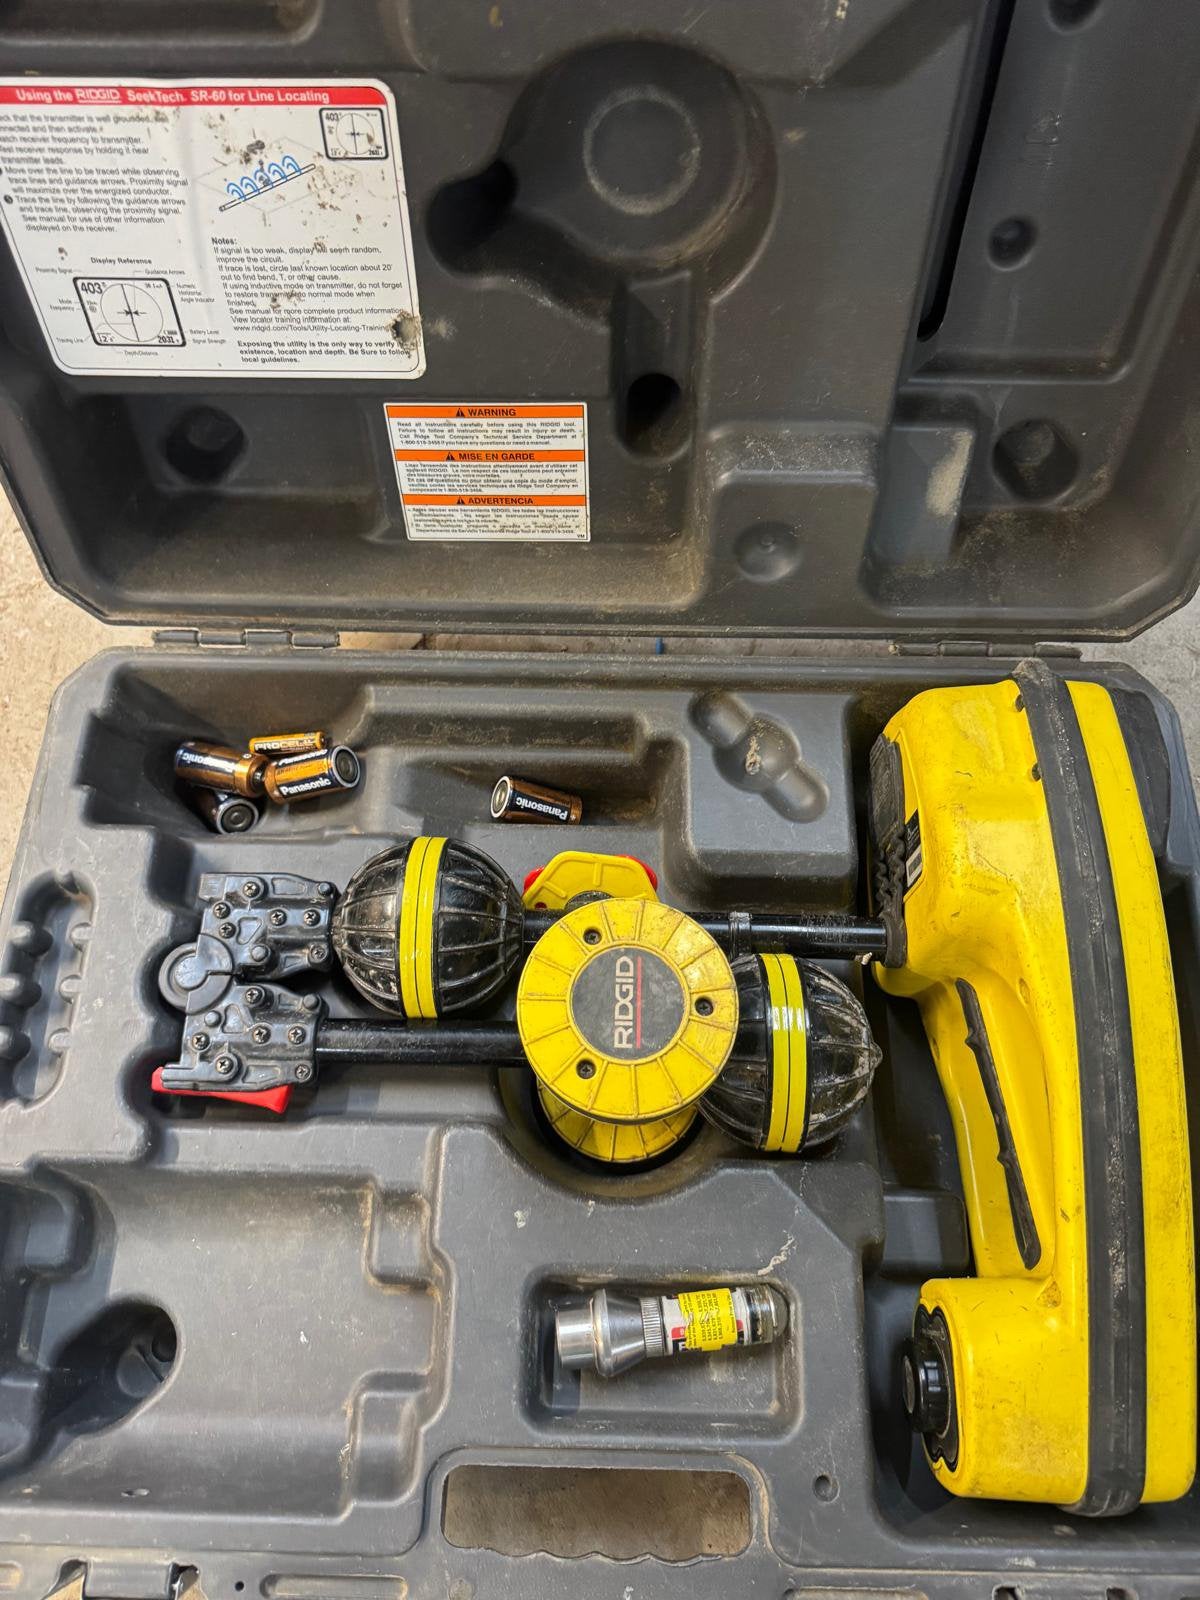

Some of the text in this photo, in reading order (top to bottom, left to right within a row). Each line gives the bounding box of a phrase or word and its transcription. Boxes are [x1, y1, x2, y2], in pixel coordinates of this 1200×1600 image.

[16, 88, 52, 102] Using
[54, 90, 73, 100] the
[76, 89, 120, 101] RIDGID
[191, 90, 226, 101] SR-60
[228, 90, 245, 101] for
[248, 90, 274, 101] Line
[277, 90, 330, 104] Locating
[15, 195, 36, 203] Trace
[38, 196, 50, 204] the
[51, 196, 65, 204] line
[66, 197, 75, 205] by
[77, 196, 110, 206] following
[125, 198, 159, 206] guidance
[161, 198, 186, 206] arrows
[72, 206, 108, 215] observing
[109, 206, 121, 214] the
[123, 207, 156, 216] proximity
[123, 216, 165, 224] information
[26, 224, 60, 232] displayed
[211, 237, 238, 245] Notes:
[221, 247, 242, 255] signal
[288, 246, 314, 255] display
[90, 257, 116, 265] Display
[216, 256, 245, 264] improve
[290, 264, 304, 272] last
[305, 264, 328, 272] known
[81, 282, 102, 294] 403
[250, 282, 282, 290] inductive
[284, 282, 304, 290] mode
[382, 282, 402, 290] forget
[275, 316, 301, 324] training
[237, 340, 272, 348] Exposing
[468, 408, 516, 416] WARNING
[468, 497, 533, 505] ADVERTENCIA
[280, 778, 332, 795] Panasonic
[516, 797, 568, 820] Panasonic
[614, 955, 634, 1048] RIDGID
